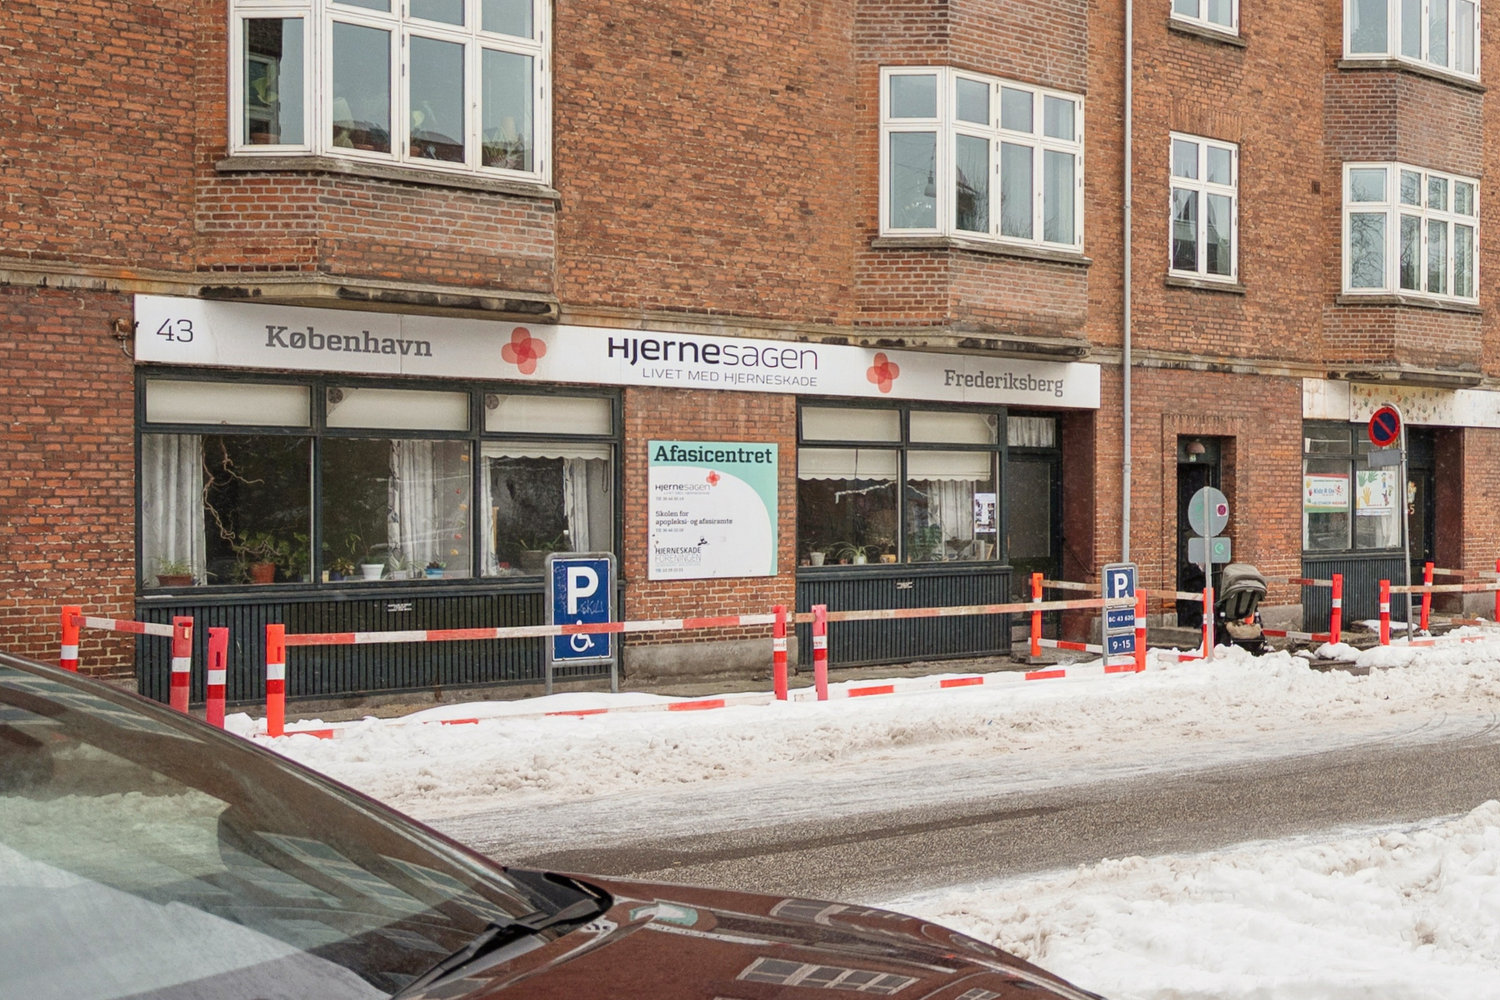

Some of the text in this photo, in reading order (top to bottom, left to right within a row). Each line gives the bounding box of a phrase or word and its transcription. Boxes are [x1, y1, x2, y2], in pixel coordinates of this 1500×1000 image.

[156, 318, 194, 342] 43
[265, 325, 433, 357] København
[642, 368, 818, 387] LIVET MED HJERNESKADE
[943, 369, 1064, 398] Frederiksberg
[654, 444, 772, 464] Afasicentret
[655, 546, 701, 554] HJERNESKADE
[567, 566, 599, 615] P
[1114, 573, 1128, 600] P
